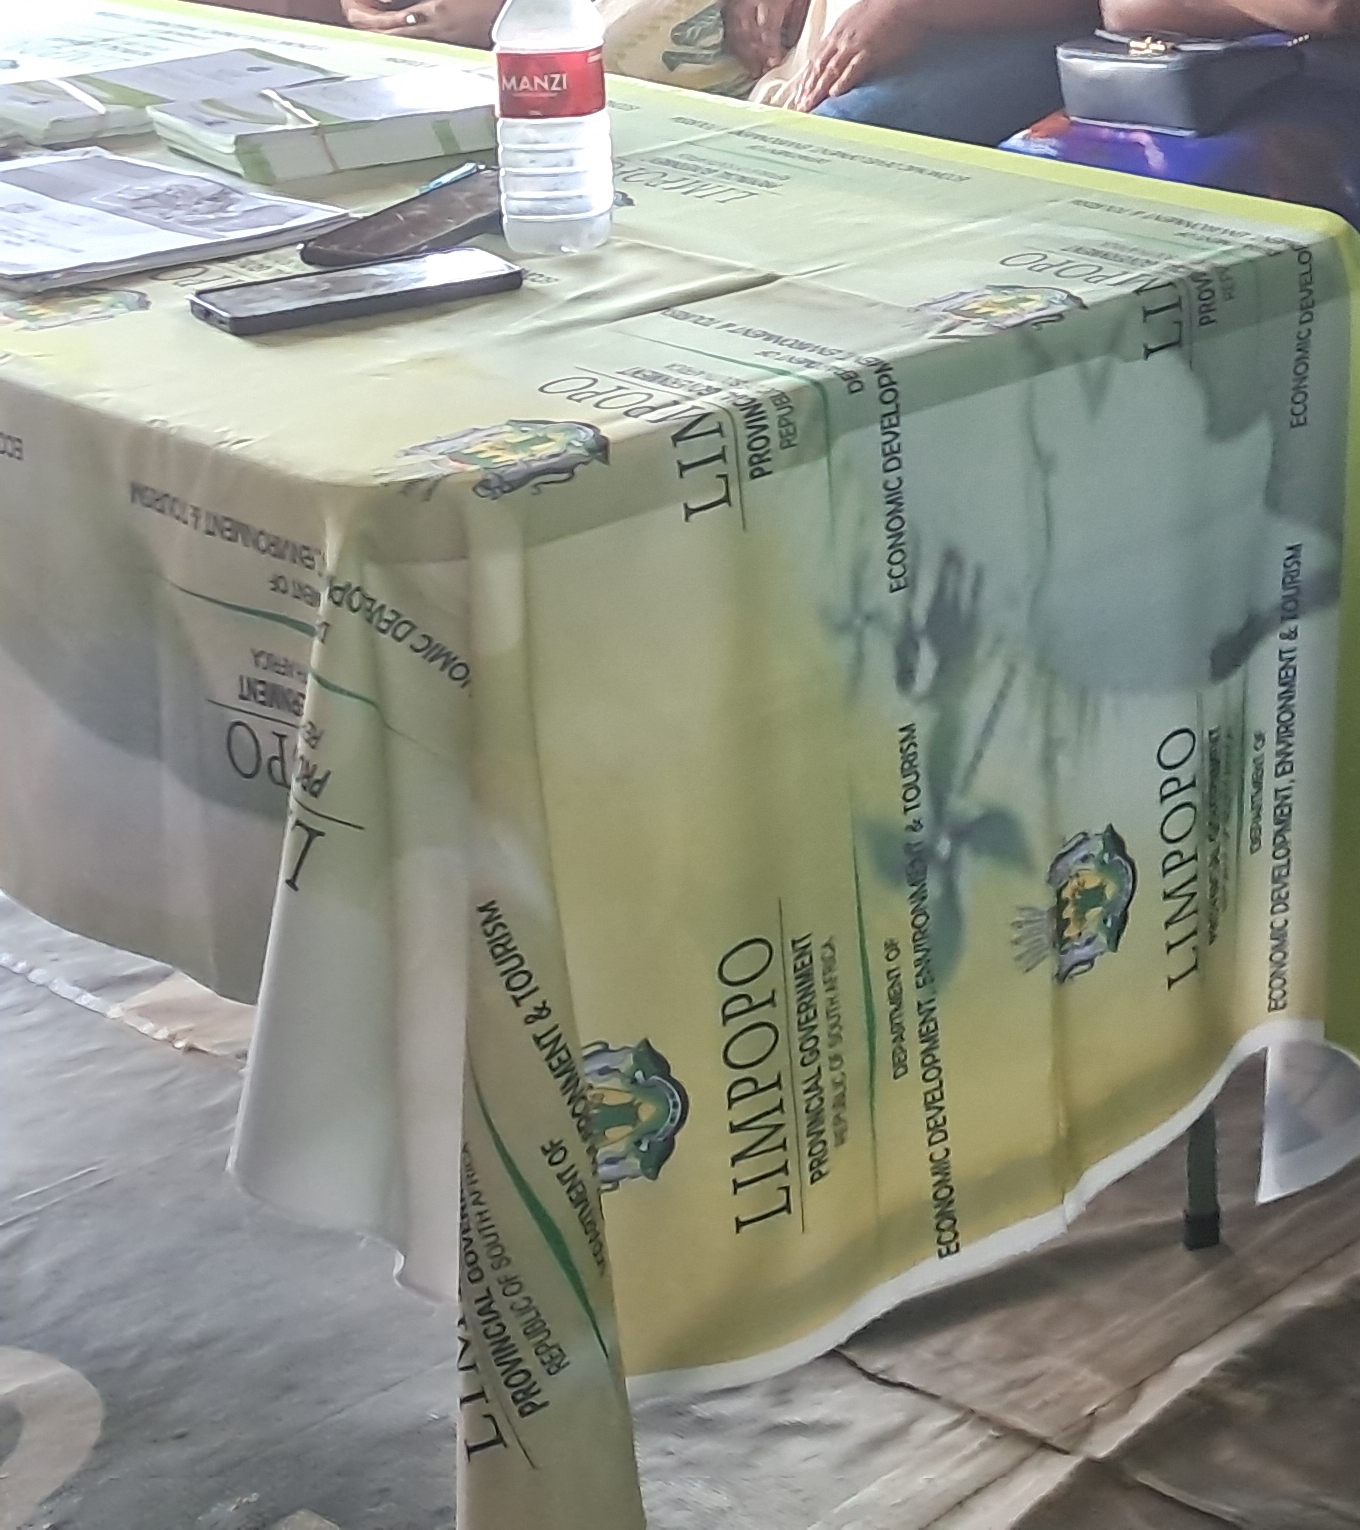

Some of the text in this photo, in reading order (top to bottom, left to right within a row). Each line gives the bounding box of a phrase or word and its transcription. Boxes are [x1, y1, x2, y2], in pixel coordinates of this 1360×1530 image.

[502, 73, 568, 94] MANZI
[1000, 252, 1184, 362] LIMPOPO
[1290, 327, 1313, 429] ECONOMIC
[537, 375, 733, 524] LIMPOPO
[883, 474, 909, 594] ECONOMIC
[1281, 542, 1303, 621] TOURISM
[1278, 624, 1299, 643] &
[1274, 647, 1298, 779] ENVIRONMENT
[898, 722, 921, 815] TOURISM
[904, 817, 925, 833] &
[1156, 726, 1198, 991] LIMPOPO
[476, 899, 540, 1007] TOURISM
[1268, 917, 1290, 1013] ECONOMIC
[523, 999, 553, 1026] &
[791, 932, 830, 1186] PROVINCIAL GOVERNMENT
[886, 970, 908, 1081] DEPARTMENT
[717, 937, 792, 1234] LIMPOPO
[539, 1137, 568, 1167] OF
[930, 1147, 962, 1258] ECONOMIC
[476, 1210, 511, 1271] SOUTH
[498, 1267, 524, 1298] OF
[473, 1284, 550, 1419] PROVINCIAL
[510, 1293, 572, 1376] REPUBLIC
